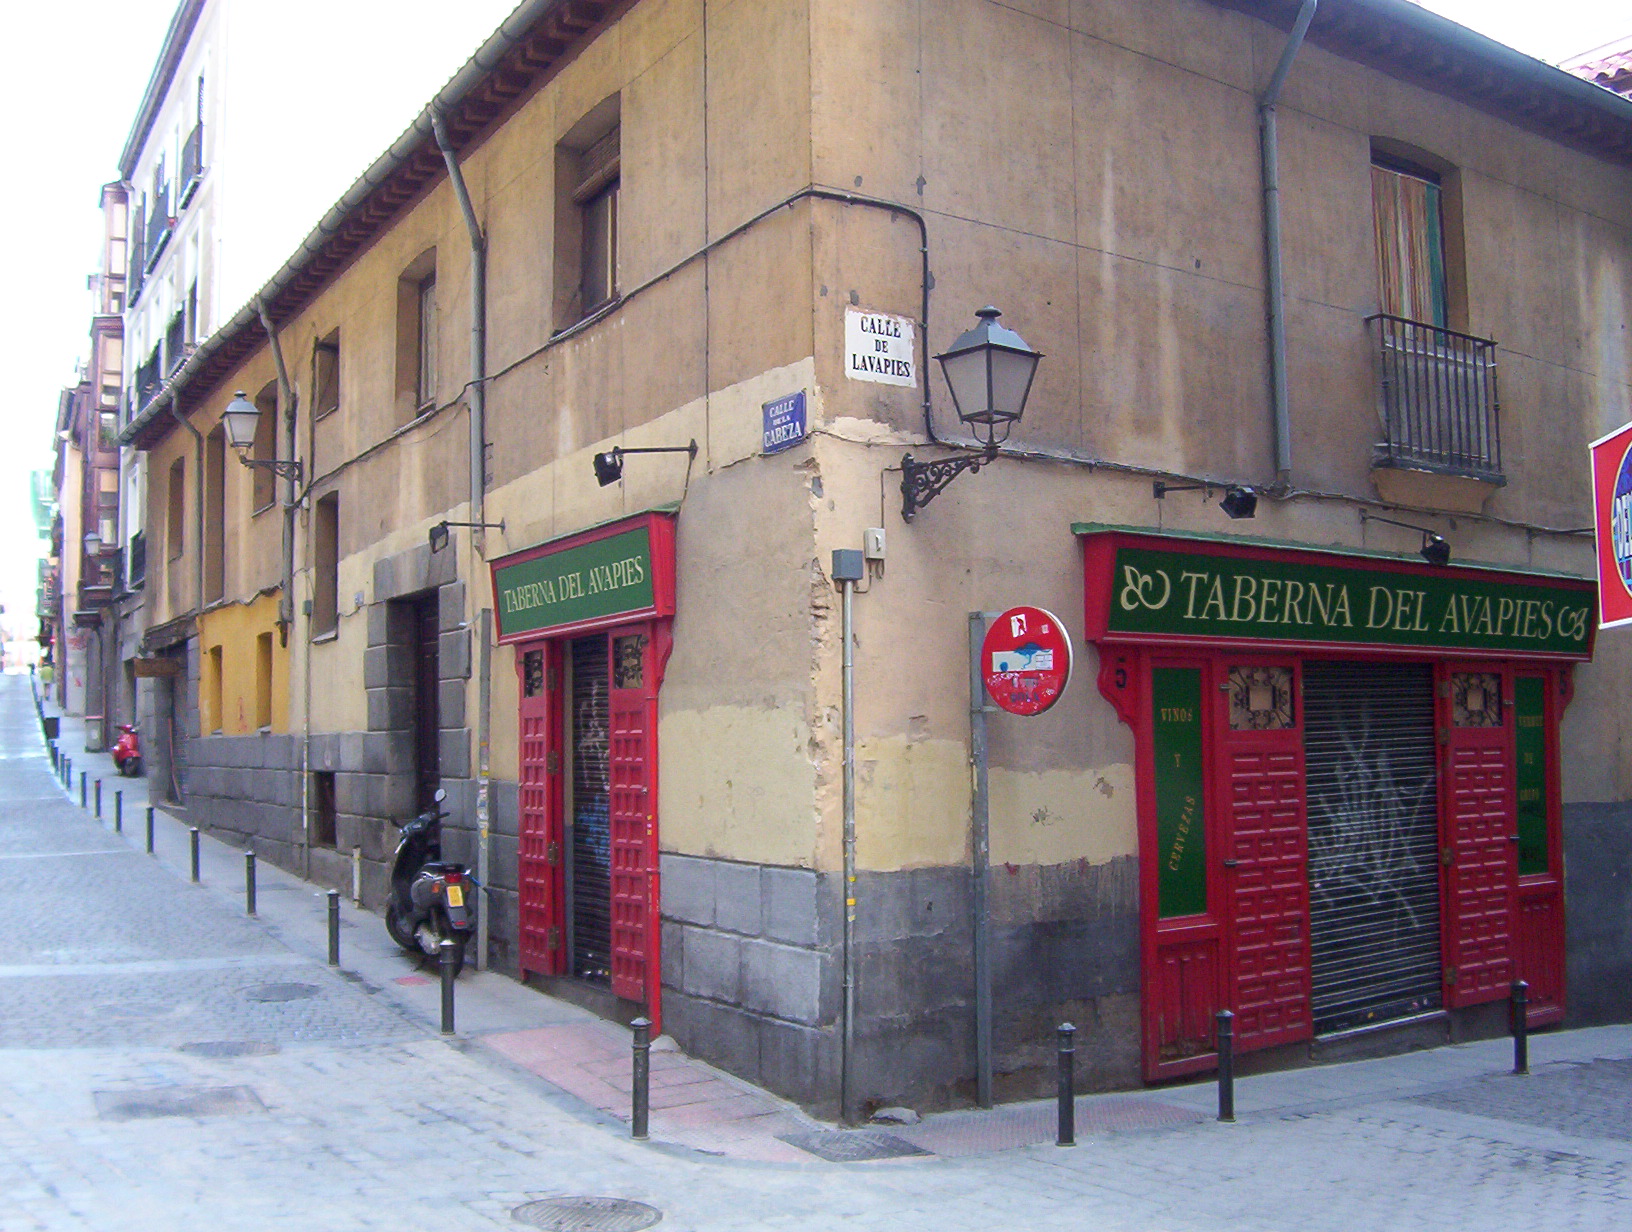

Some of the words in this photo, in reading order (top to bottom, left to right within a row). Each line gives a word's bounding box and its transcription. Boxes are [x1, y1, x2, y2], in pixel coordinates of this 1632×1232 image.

[860, 316, 901, 338] CALLE
[874, 339, 889, 353] DE
[852, 353, 911, 378] LAVAPIES
[770, 400, 795, 418] CALLE
[764, 421, 803, 447] CABEZA
[504, 580, 557, 613] TABERNA
[558, 572, 585, 602] DEL
[588, 555, 644, 595] AVAPIES
[1180, 570, 1354, 627] TABERNA
[1365, 585, 1430, 632] DEL
[1438, 593, 1554, 640] AVAPIES
[1160, 708, 1193, 722] VINOS
[1168, 795, 1196, 872] CERVEZAS
